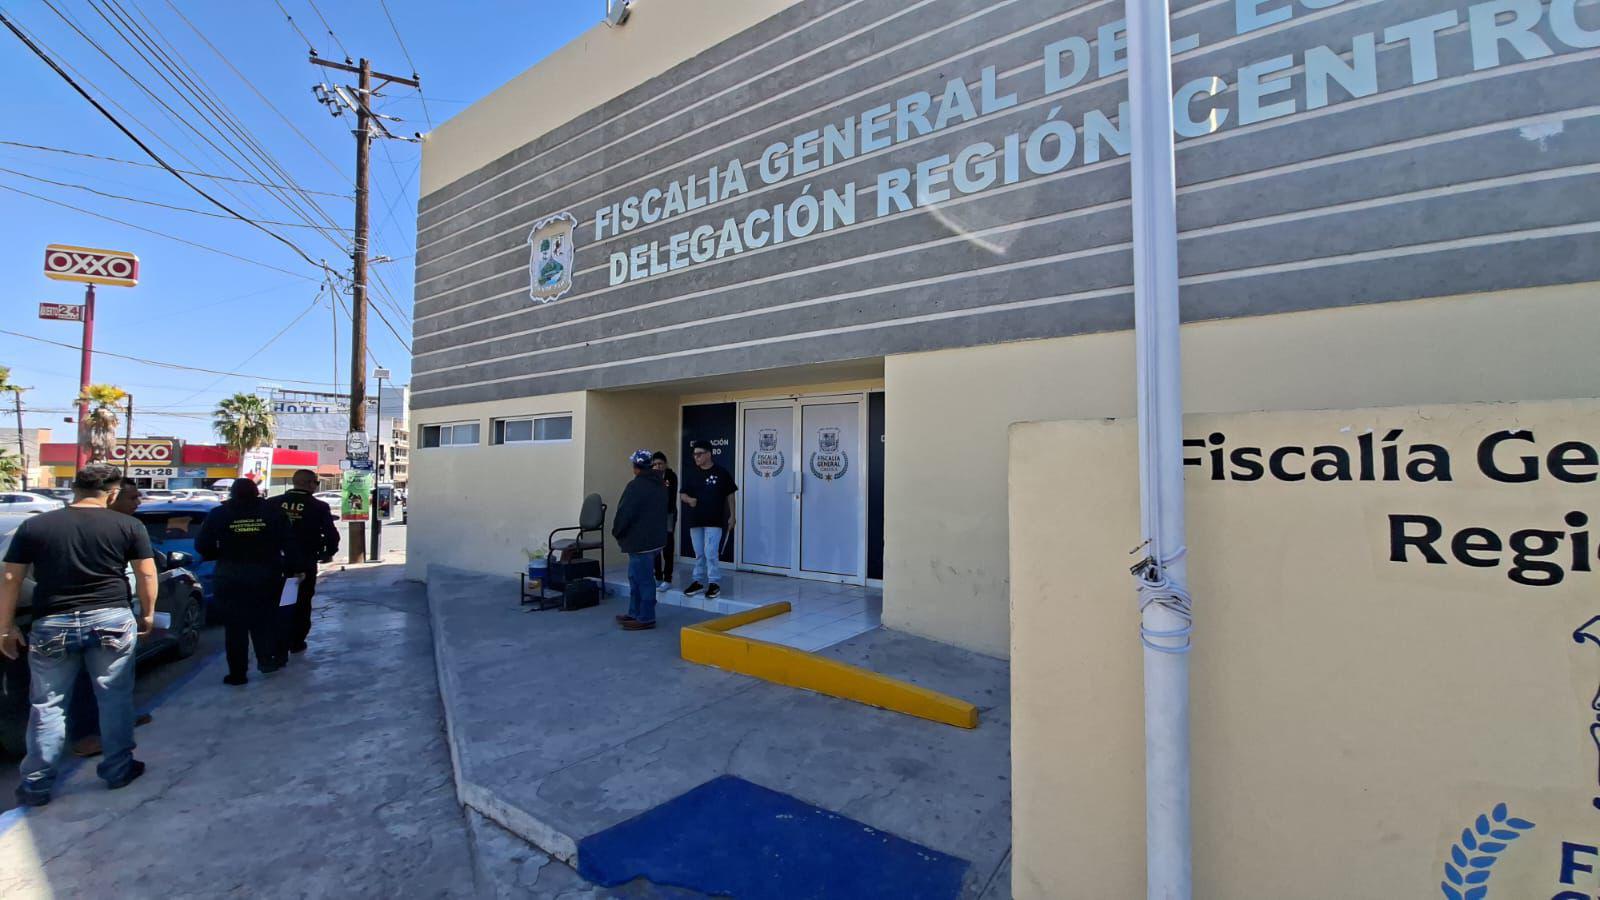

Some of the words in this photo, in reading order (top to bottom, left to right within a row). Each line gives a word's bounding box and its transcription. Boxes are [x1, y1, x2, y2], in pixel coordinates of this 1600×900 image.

[595, 158, 748, 241] FISCALIA
[759, 66, 1018, 184] GENERAL
[609, 182, 855, 286] DELEGACIÓN
[877, 100, 1131, 217] REGIÓN
[48, 252, 132, 277] OXXO
[59, 304, 80, 316] 24
[112, 445, 169, 460] OXXO
[1477, 430, 1600, 483] Ge
[281, 502, 304, 511] AIC
[1388, 510, 1600, 586] Regi
